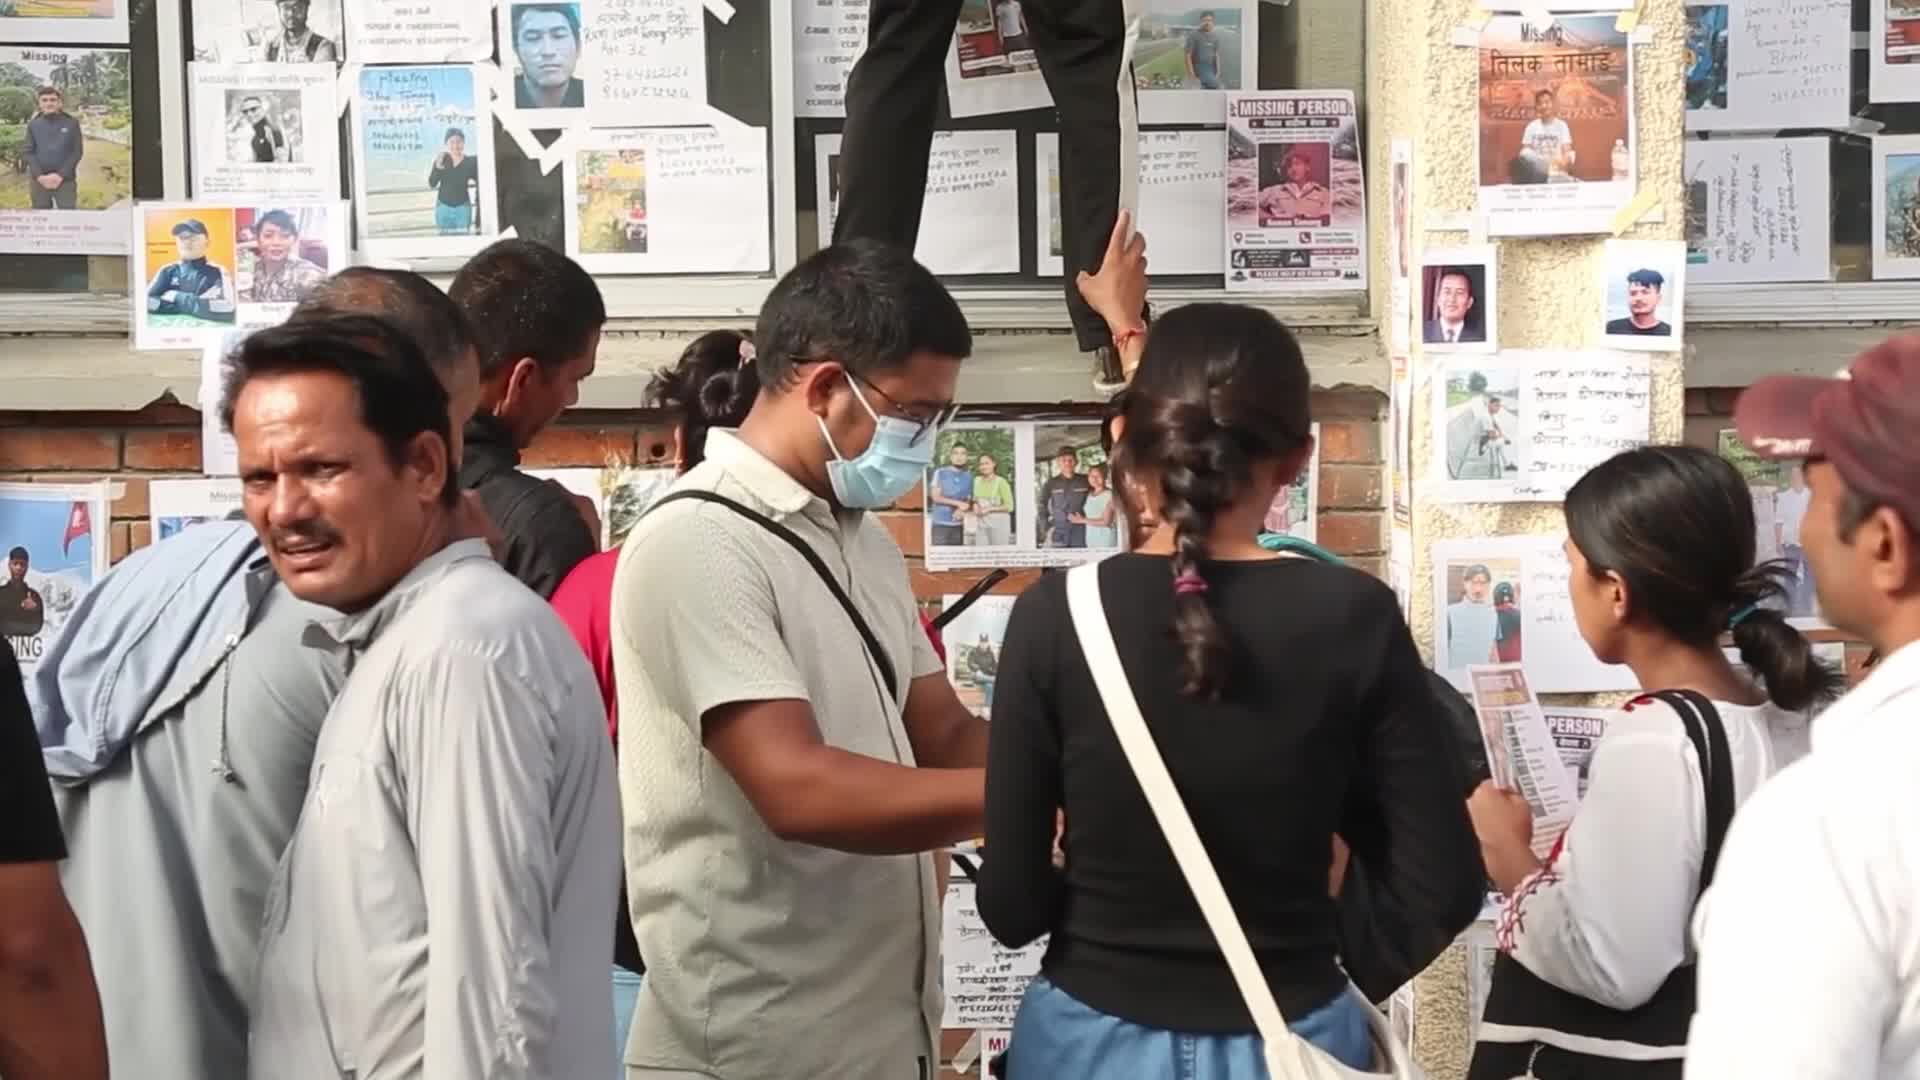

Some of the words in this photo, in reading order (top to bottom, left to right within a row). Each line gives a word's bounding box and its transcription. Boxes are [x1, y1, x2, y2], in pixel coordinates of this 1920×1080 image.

[21, 51, 68, 64] Missing
[1491, 48, 1544, 77] तिलक
[1239, 100, 1295, 116] MISSING
[1297, 100, 1347, 115] PERSON
[1550, 718, 1601, 736] PERSON
